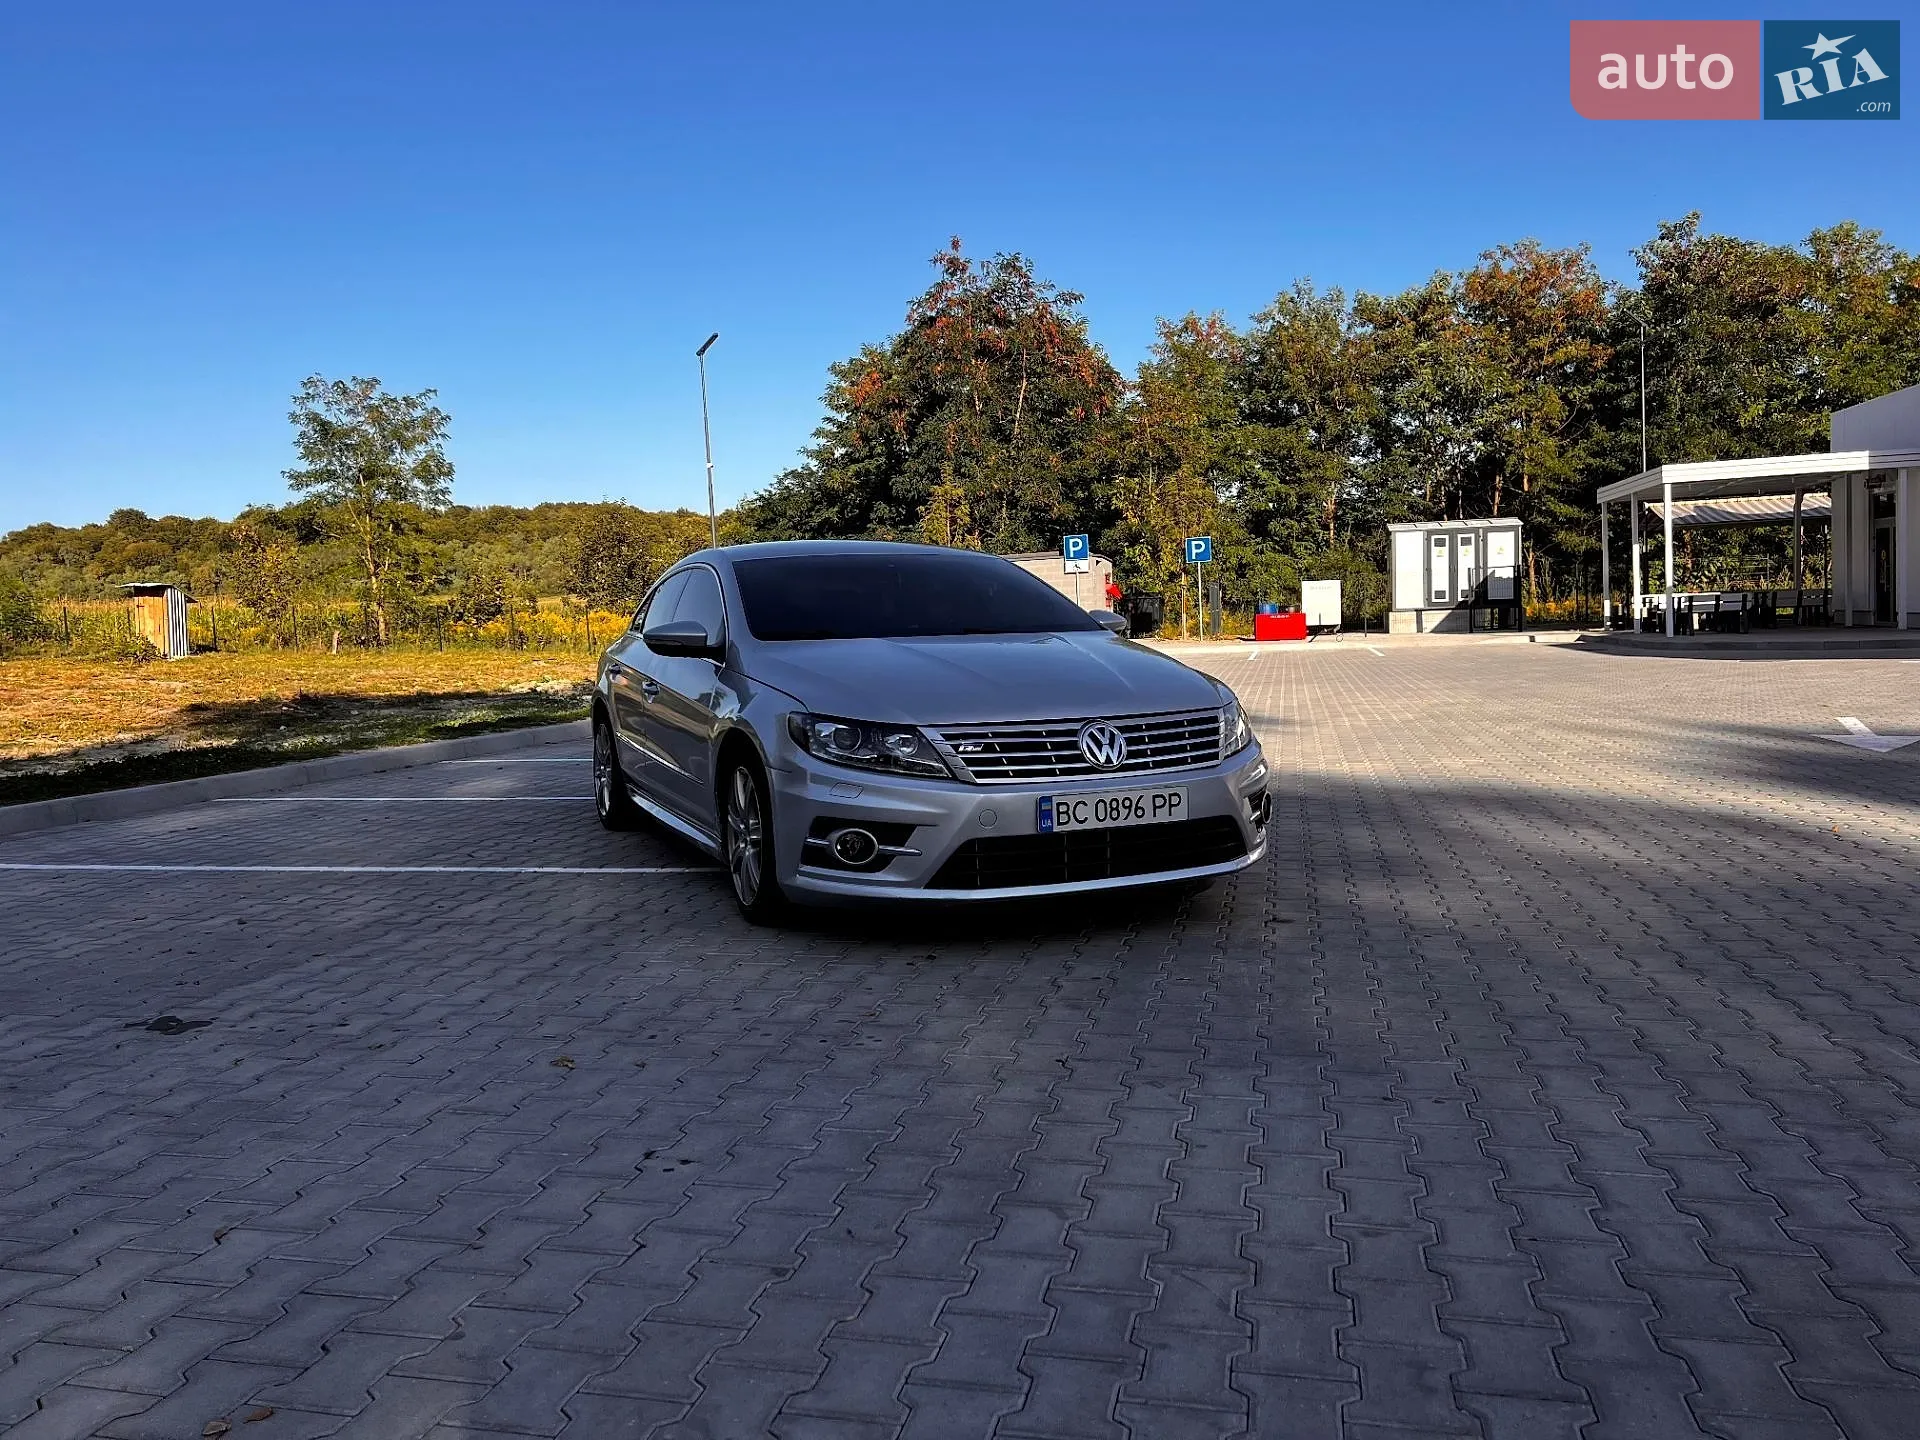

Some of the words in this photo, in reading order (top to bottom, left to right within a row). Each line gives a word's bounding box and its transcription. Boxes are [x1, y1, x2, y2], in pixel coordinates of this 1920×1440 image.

[1069, 538, 1083, 558] P
[1191, 540, 1206, 560] P
[1056, 800, 1089, 827] BC
[1094, 795, 1146, 823] 0896
[1152, 792, 1182, 818] PP
[1041, 818, 1052, 828] UA
